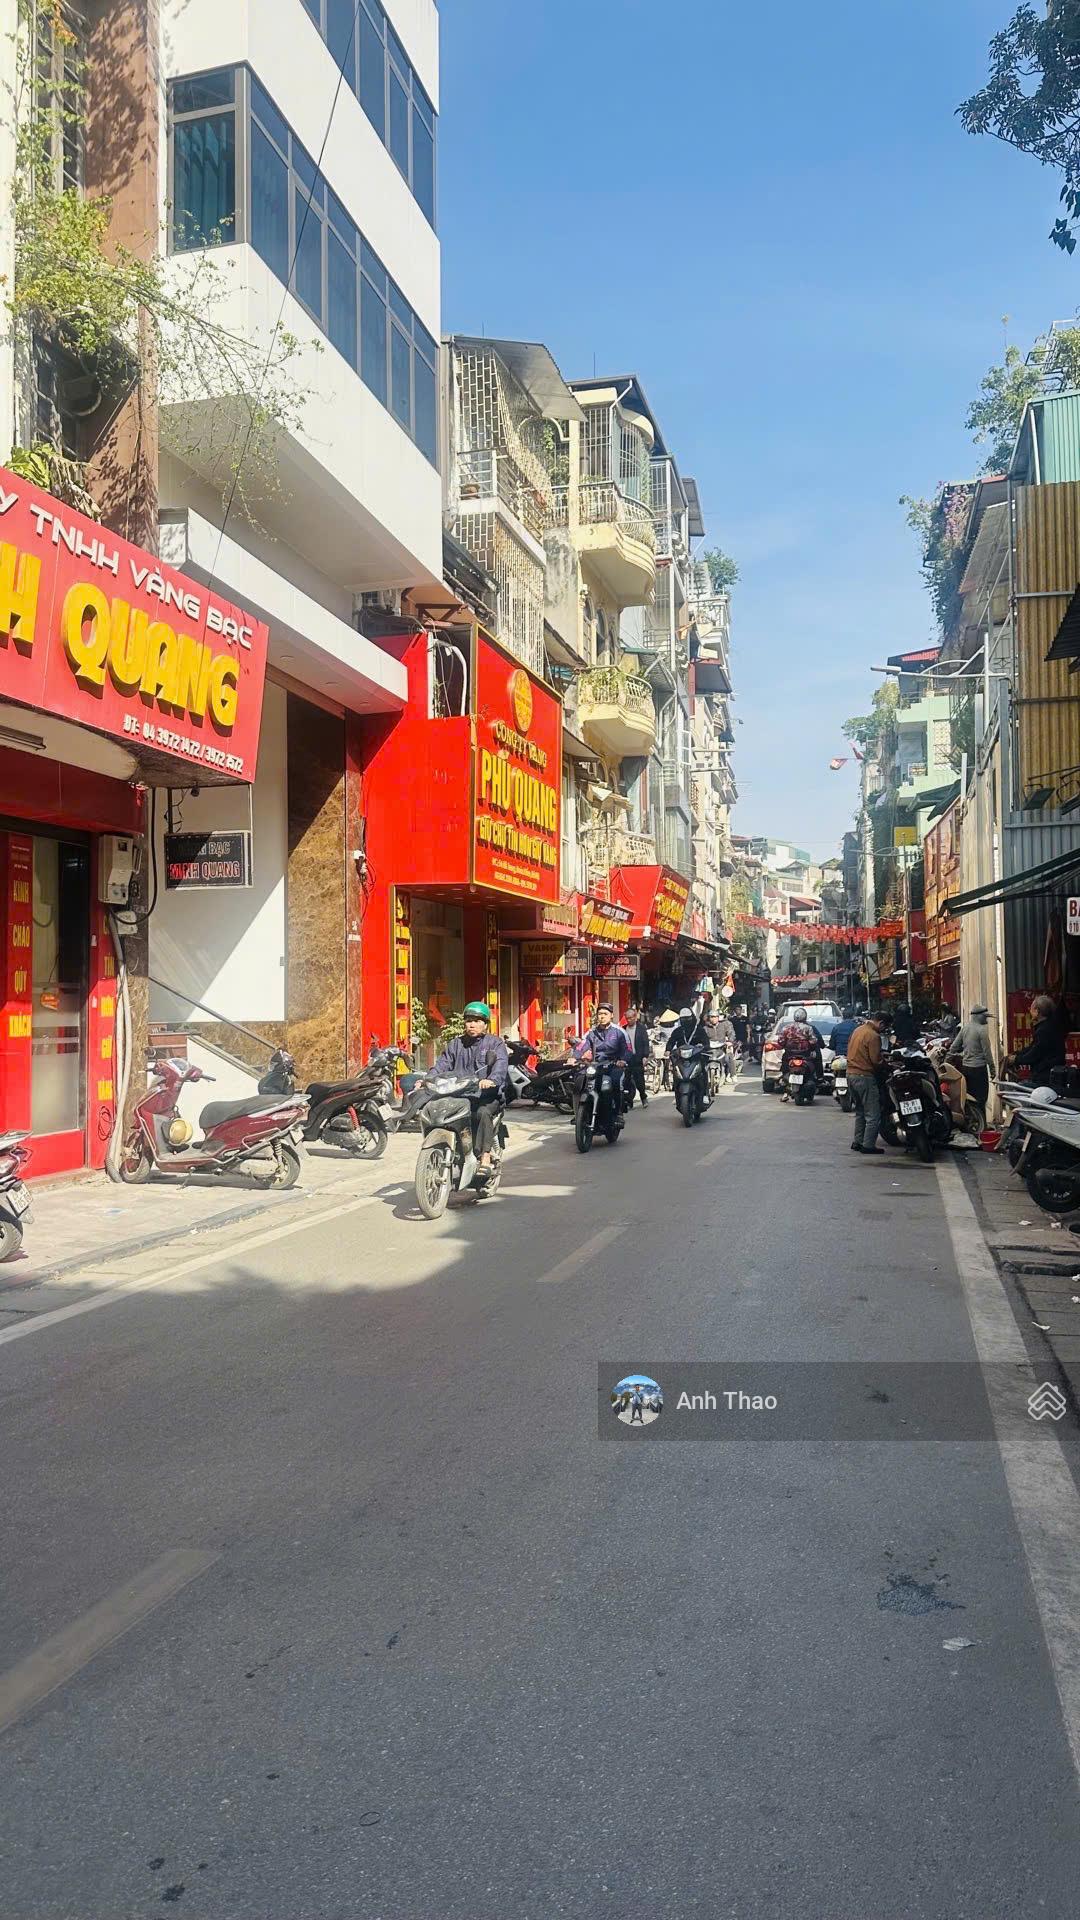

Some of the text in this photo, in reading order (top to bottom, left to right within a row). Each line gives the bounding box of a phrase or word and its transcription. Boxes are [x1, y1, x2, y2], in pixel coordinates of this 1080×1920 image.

[30, 504, 119, 576] TNHH
[129, 558, 200, 621] VÀNG
[206, 605, 253, 649] BẠC
[62, 582, 240, 733] QUANG
[514, 767, 557, 832] QUANG
[169, 861, 240, 879] MINH QUANG
